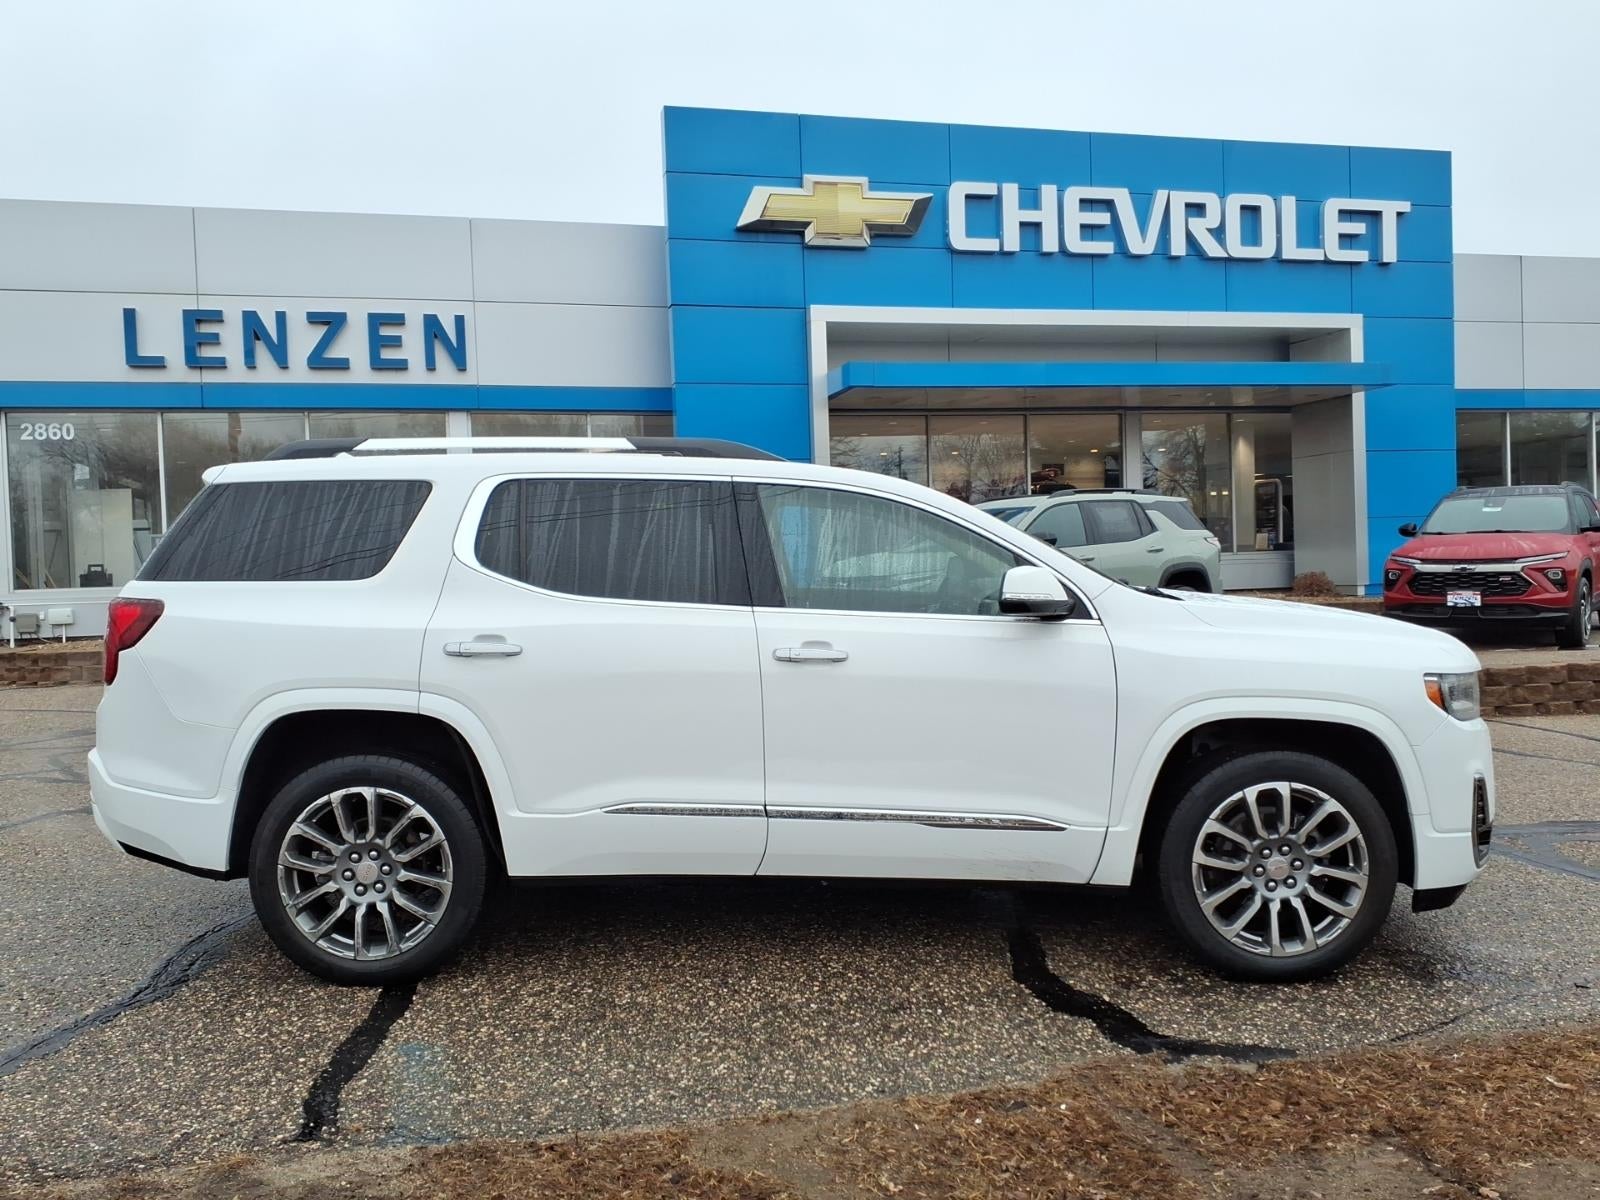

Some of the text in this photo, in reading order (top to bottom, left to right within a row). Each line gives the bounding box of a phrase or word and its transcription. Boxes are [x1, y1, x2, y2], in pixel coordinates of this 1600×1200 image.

[948, 181, 1412, 264] CHEVROLET
[123, 307, 468, 371] LENZEN
[20, 423, 75, 440] 2860
